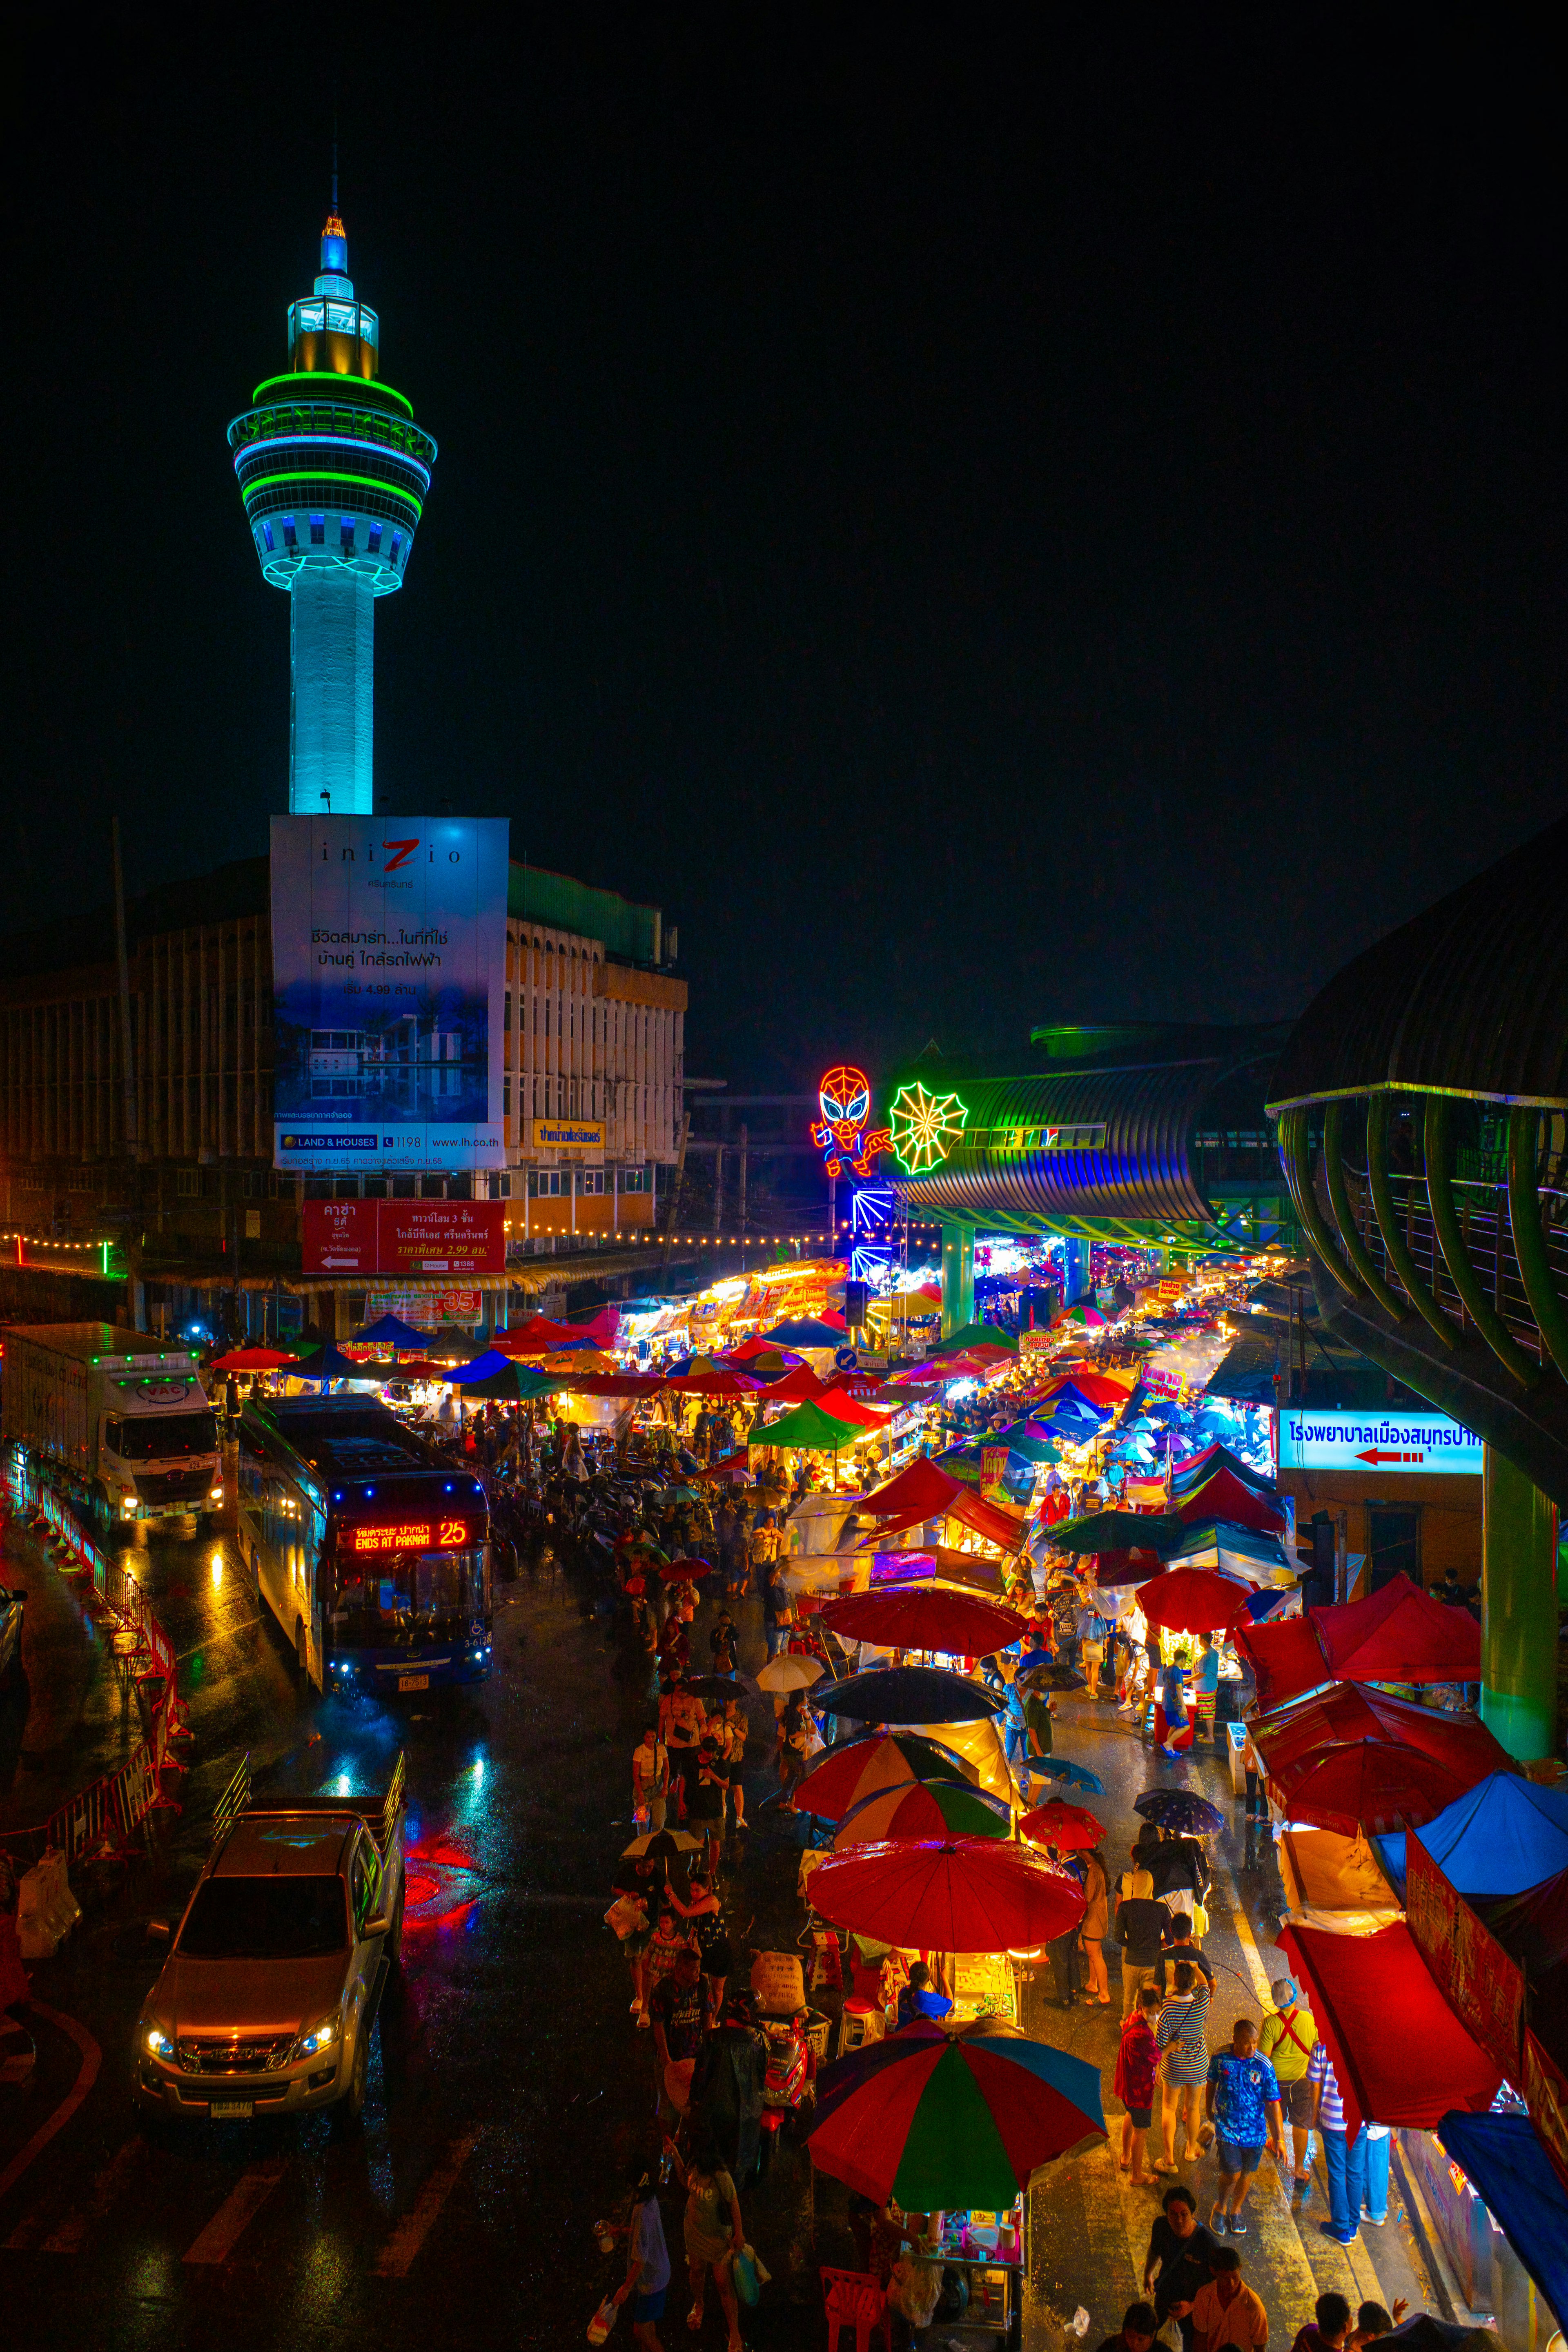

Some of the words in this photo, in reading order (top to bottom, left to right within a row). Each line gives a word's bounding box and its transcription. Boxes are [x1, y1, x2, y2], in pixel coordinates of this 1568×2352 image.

[318, 950, 354, 969] บ้านคู่
[361, 950, 441, 967] ใกล้รถไฟฟ้า
[343, 981, 361, 995] เริ่ม
[366, 984, 390, 995] 4.99
[395, 984, 416, 995] ล้าน
[397, 1137, 421, 1148] 1198
[432, 1137, 499, 1147] www.lh.co.th
[324, 1203, 356, 1216] คาซ่า
[412, 1212, 449, 1223] ทาวน์โฮม
[452, 1215, 457, 1223] 3
[461, 1209, 473, 1223] ชั้น
[396, 1228, 440, 1239] ใกล้บีทีเอส
[444, 1228, 488, 1239] ศรีนครินทร์
[398, 1244, 443, 1254] ราคาพิเศษ
[447, 1245, 468, 1254] 2.99
[444, 1292, 474, 1311] 35
[440, 1523, 466, 1544] 25
[356, 1537, 379, 1550] ENDS
[381, 1536, 392, 1548] AT
[396, 1534, 430, 1547] PAKNAM
[1306, 1813, 1340, 1829] Carnation
